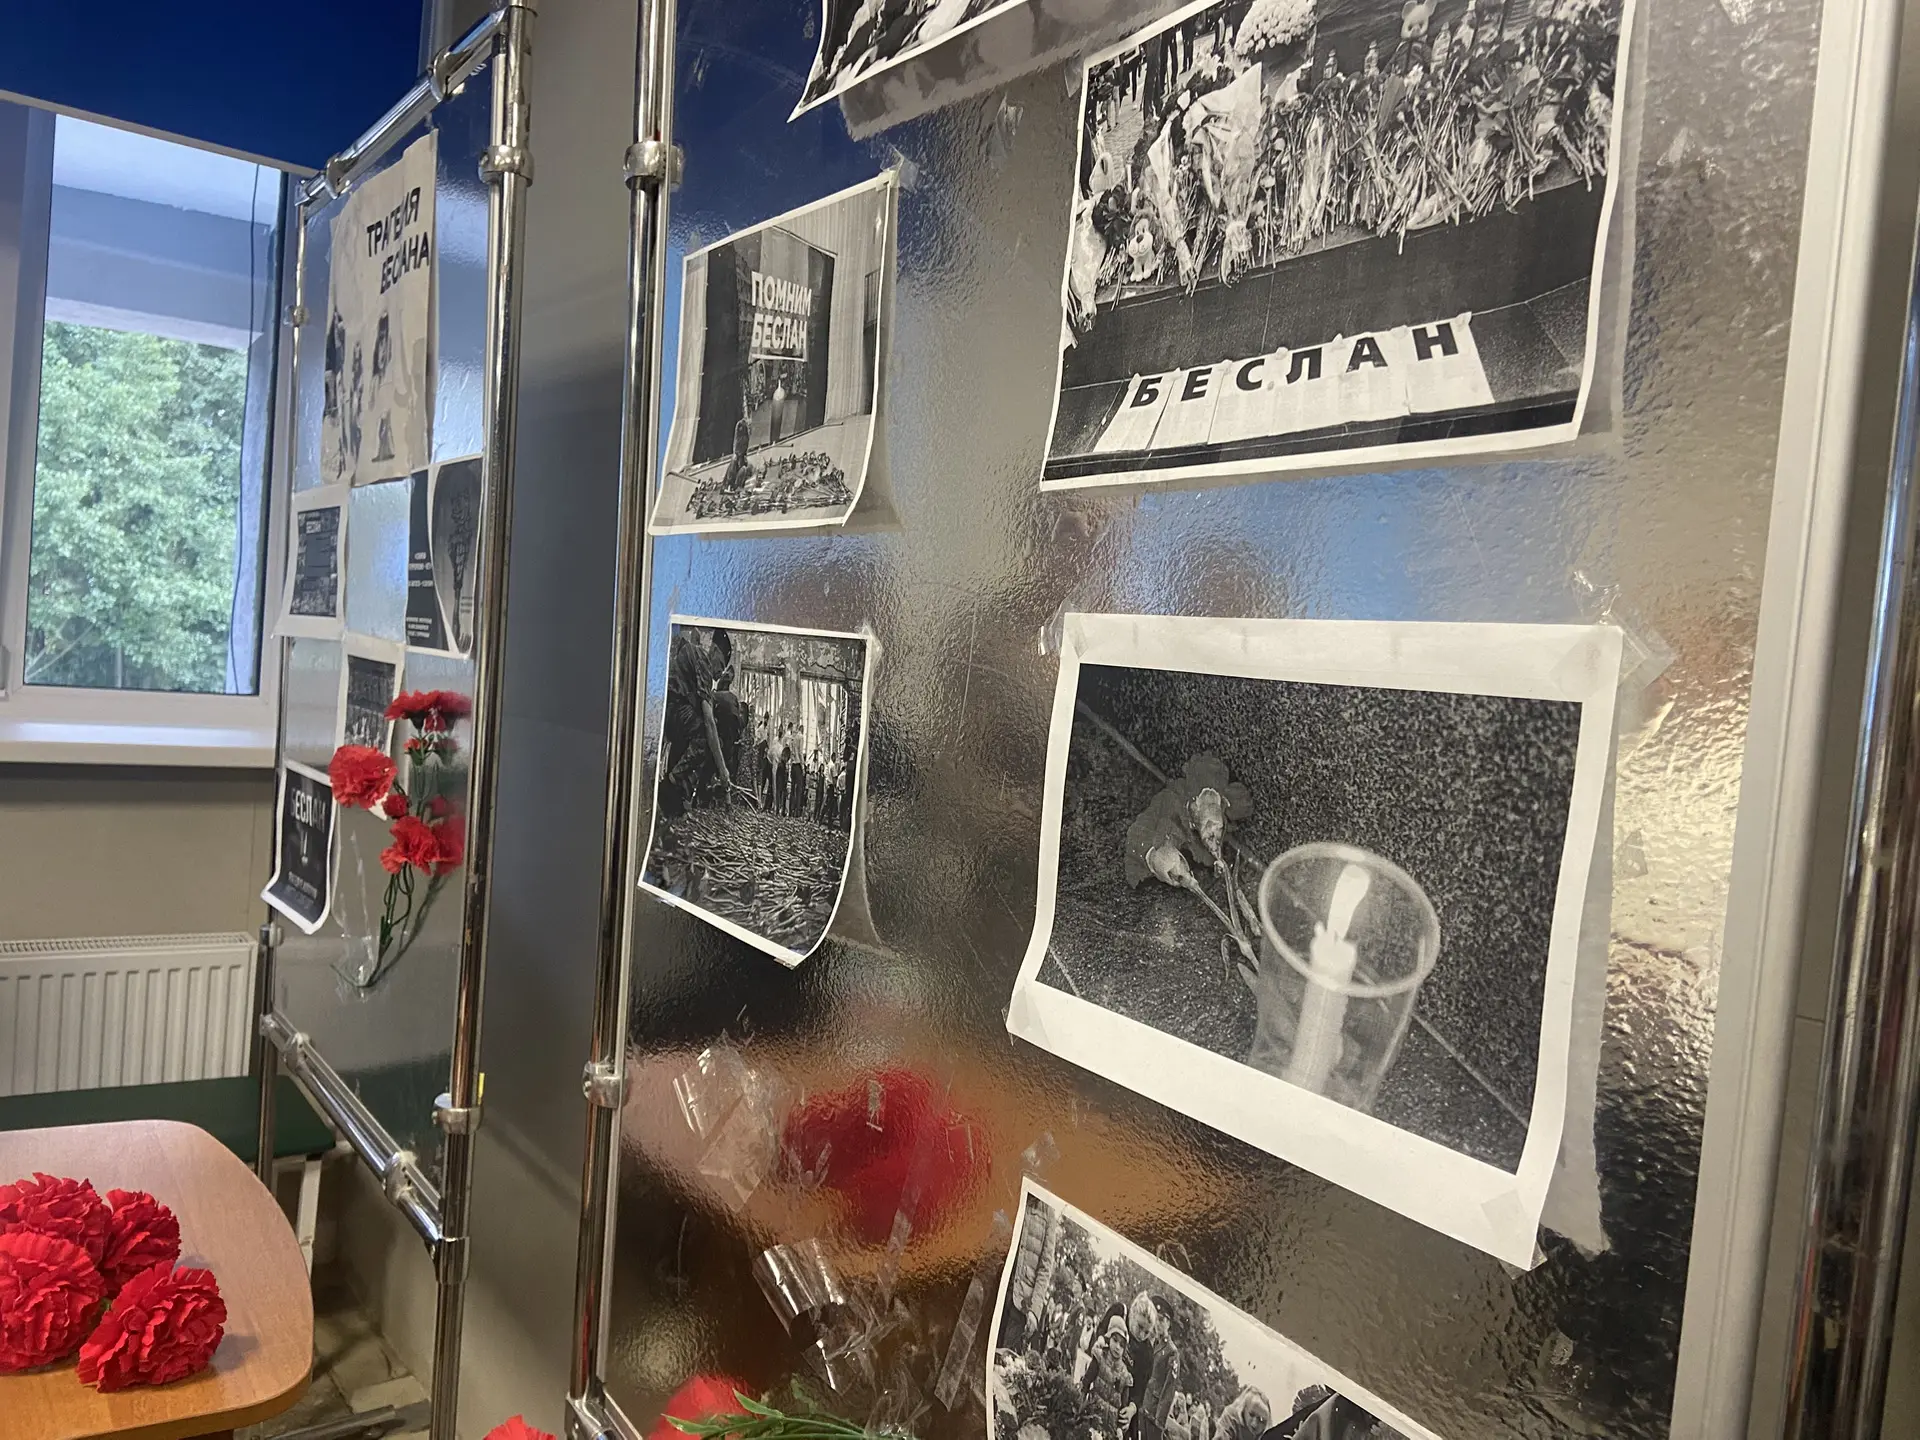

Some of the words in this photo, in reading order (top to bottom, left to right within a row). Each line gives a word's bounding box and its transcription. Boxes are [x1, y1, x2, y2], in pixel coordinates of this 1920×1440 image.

[367, 187, 421, 257] ТРАГЕИЯ
[380, 232, 429, 294] БЕСАНА
[751, 271, 812, 317] ПОМНИМ
[751, 313, 808, 349] БЕСЛАН
[1129, 322, 1459, 409] БЕСЛАН
